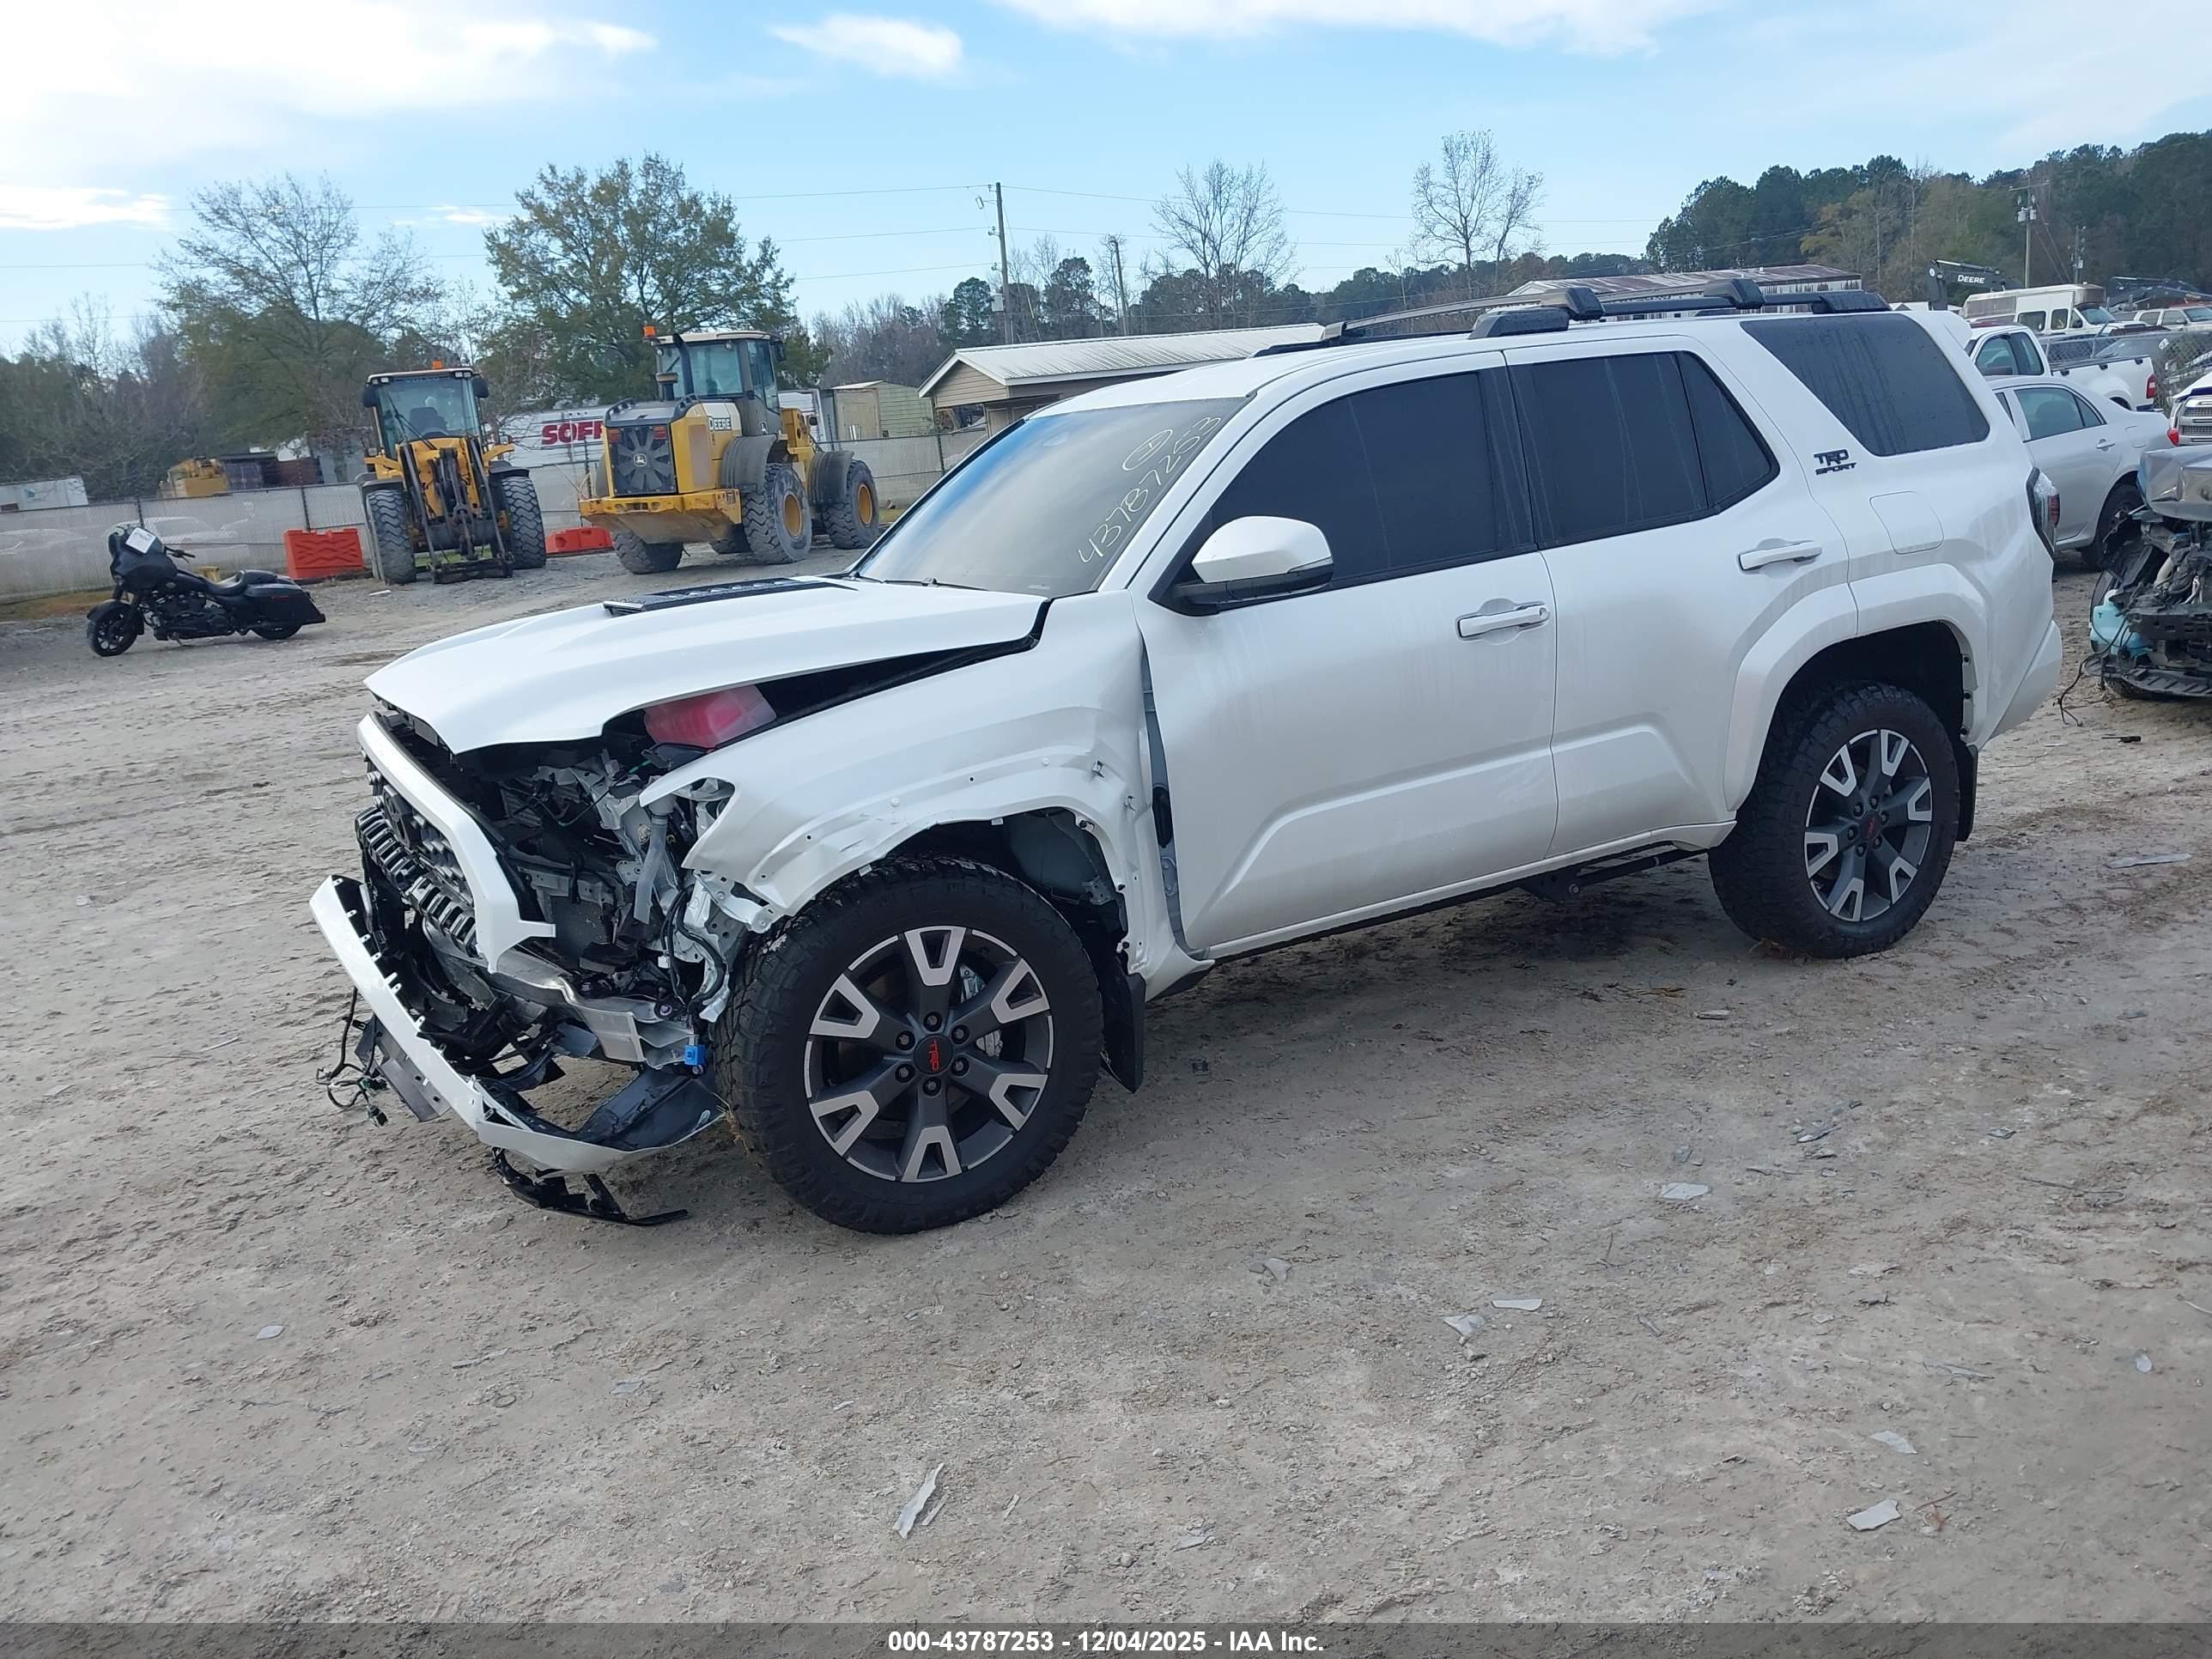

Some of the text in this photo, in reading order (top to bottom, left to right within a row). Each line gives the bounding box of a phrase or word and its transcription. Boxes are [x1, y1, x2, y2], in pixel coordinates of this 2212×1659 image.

[1957, 274, 1985, 284] DEERE
[708, 416, 731, 430] DEERE
[1813, 448, 1850, 466] TRD
[1815, 462, 1856, 475] SPORT
[1078, 416, 1221, 563] 43787253
